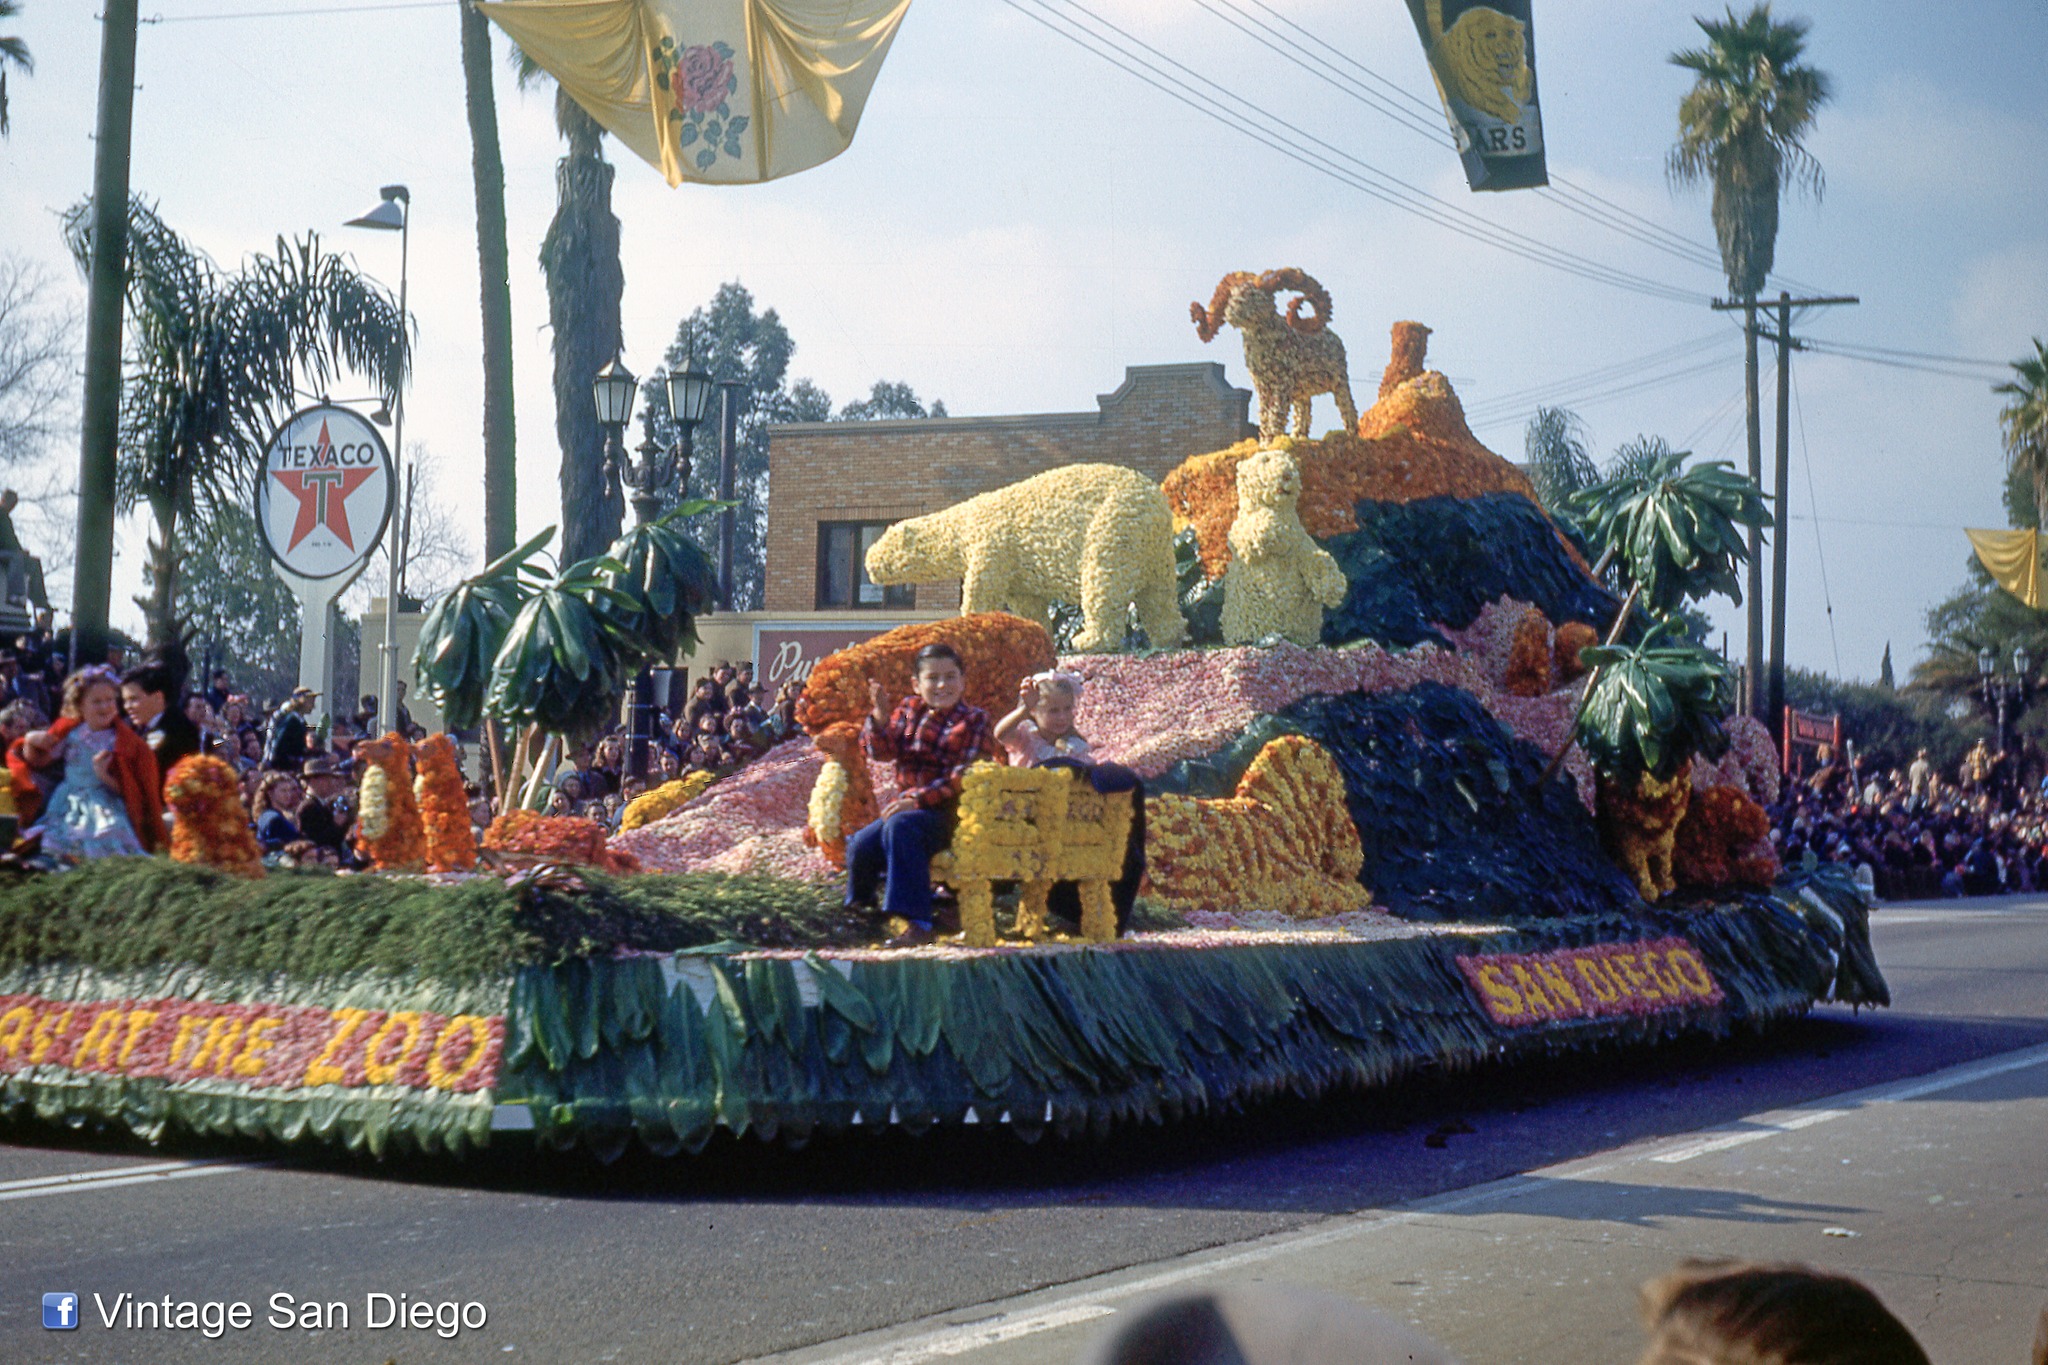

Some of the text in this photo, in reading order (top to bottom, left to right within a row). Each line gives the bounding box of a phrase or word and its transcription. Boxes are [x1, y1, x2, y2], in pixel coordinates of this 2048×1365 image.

[281, 443, 374, 468] TEXACO
[1478, 948, 1712, 1016] SAN DIEGO
[73, 1009, 159, 1068] AT
[169, 1015, 284, 1077] THE
[303, 1007, 488, 1090] ZOO
